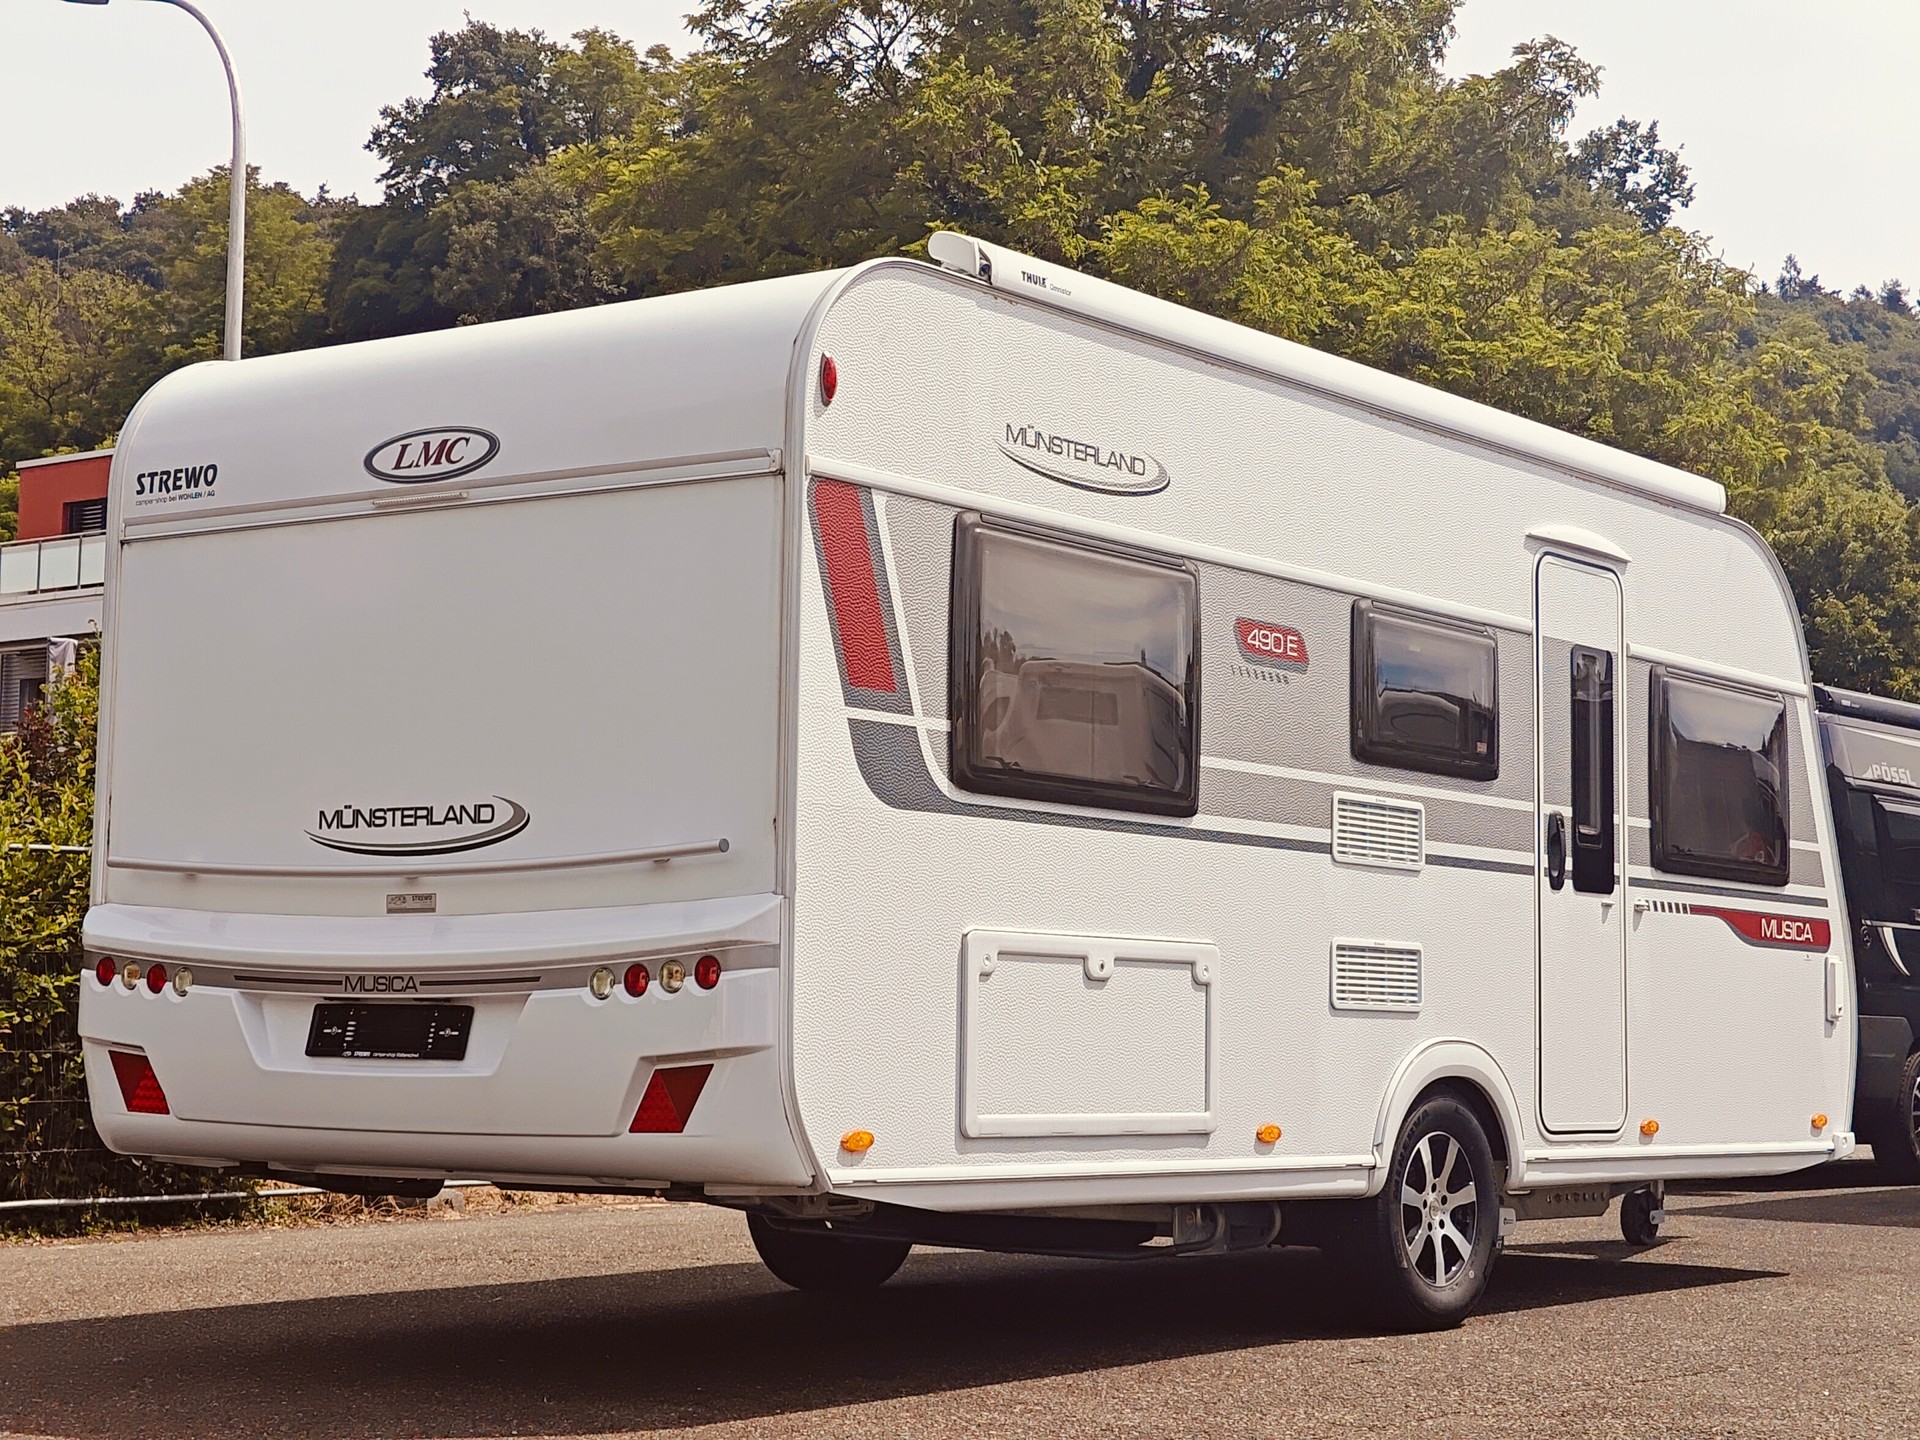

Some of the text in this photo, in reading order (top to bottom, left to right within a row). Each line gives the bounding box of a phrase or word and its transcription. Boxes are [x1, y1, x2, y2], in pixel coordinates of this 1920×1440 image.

[1021, 270, 1047, 288] THULE
[391, 436, 471, 470] LMC
[1006, 422, 1146, 476] MÜNSTERLAND
[136, 464, 218, 496] STREWO
[178, 490, 203, 501] WOHLEN
[1872, 761, 1917, 787] PÖSSL
[318, 803, 495, 831] MÜNSTERLAND
[1760, 918, 1814, 943] MUSICA
[344, 975, 419, 993] MUSICA
